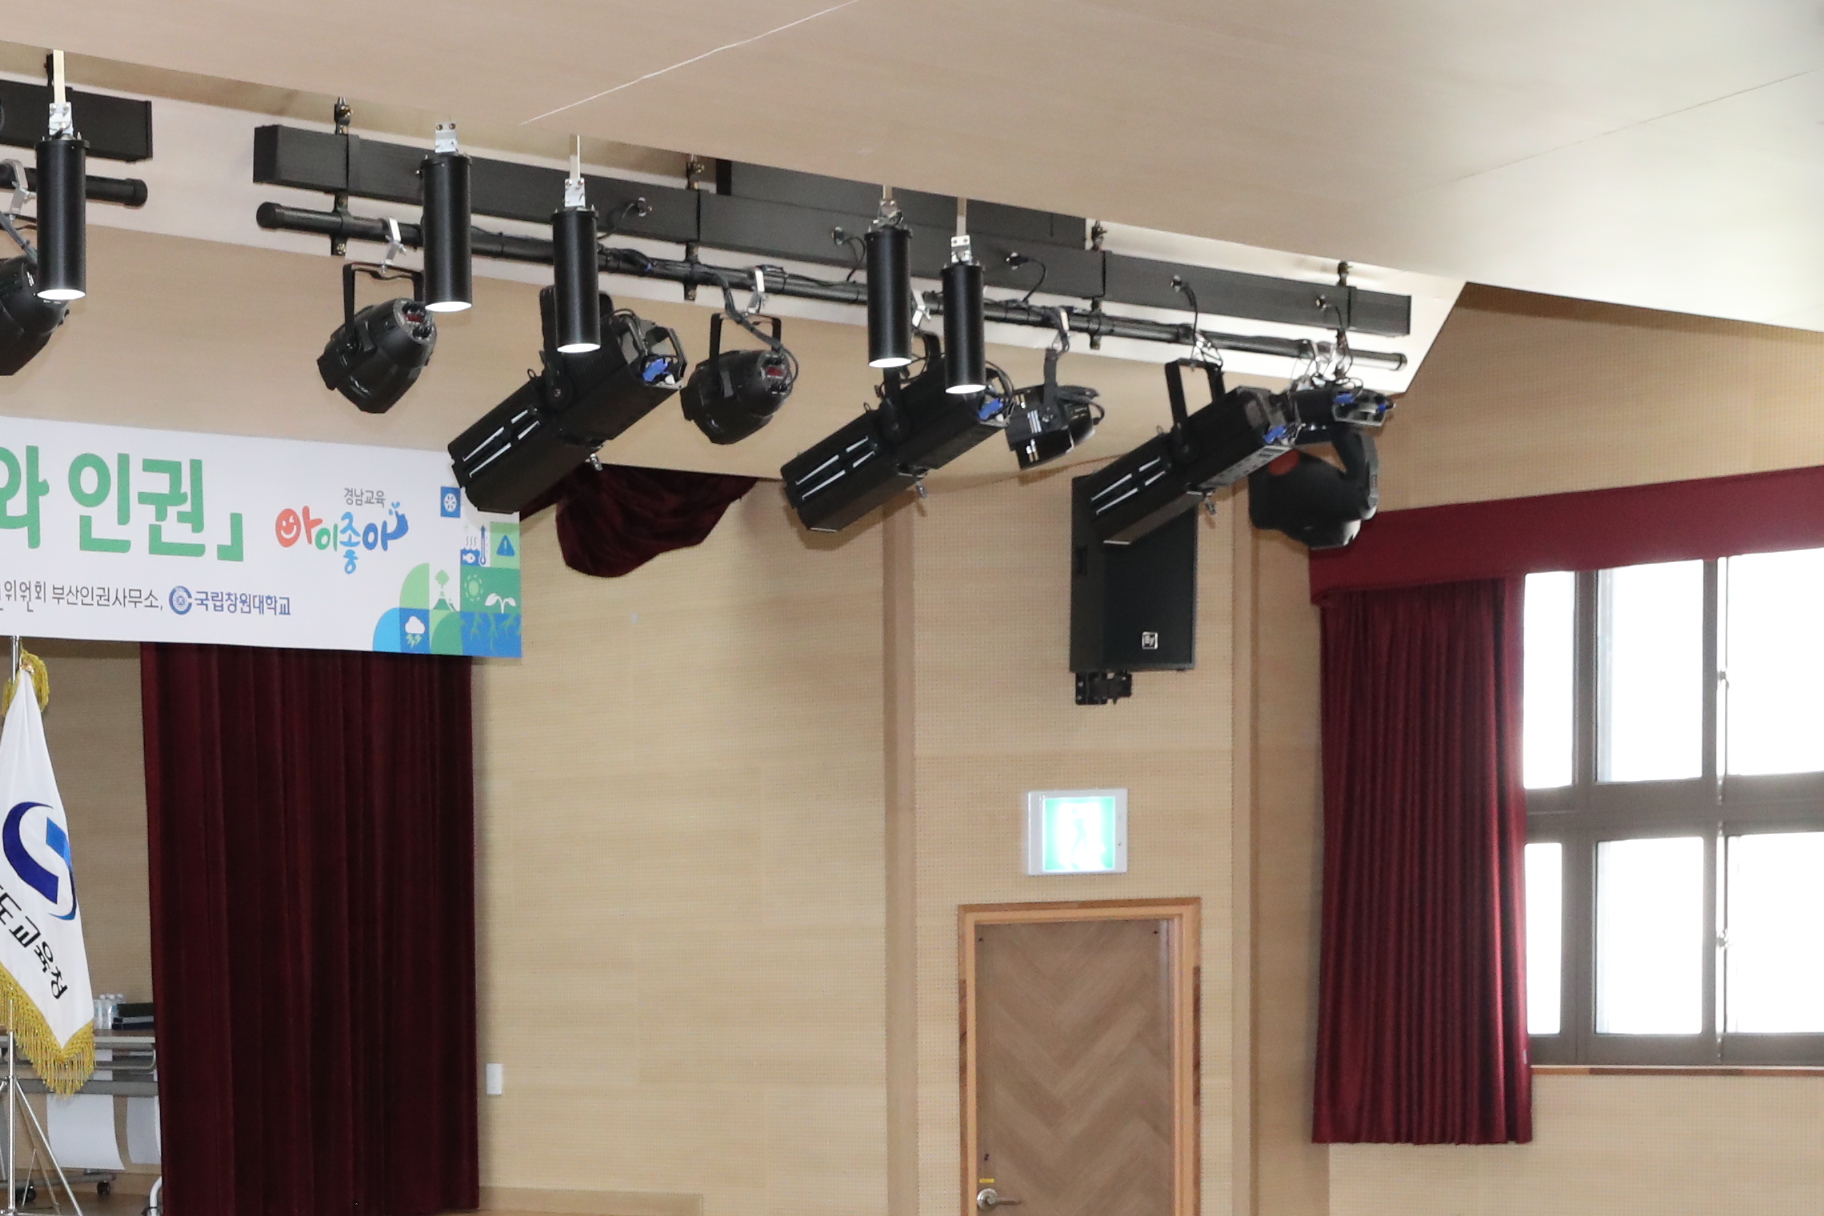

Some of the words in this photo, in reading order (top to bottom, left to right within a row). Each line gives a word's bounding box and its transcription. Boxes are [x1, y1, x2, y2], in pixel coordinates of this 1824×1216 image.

[68, 453, 244, 562] 인권」
[344, 487, 386, 508] 경남교육
[274, 504, 409, 575] 아이좋아
[51, 583, 164, 611] 부산인권사무소,
[193, 590, 292, 616] 국립창원대학교
